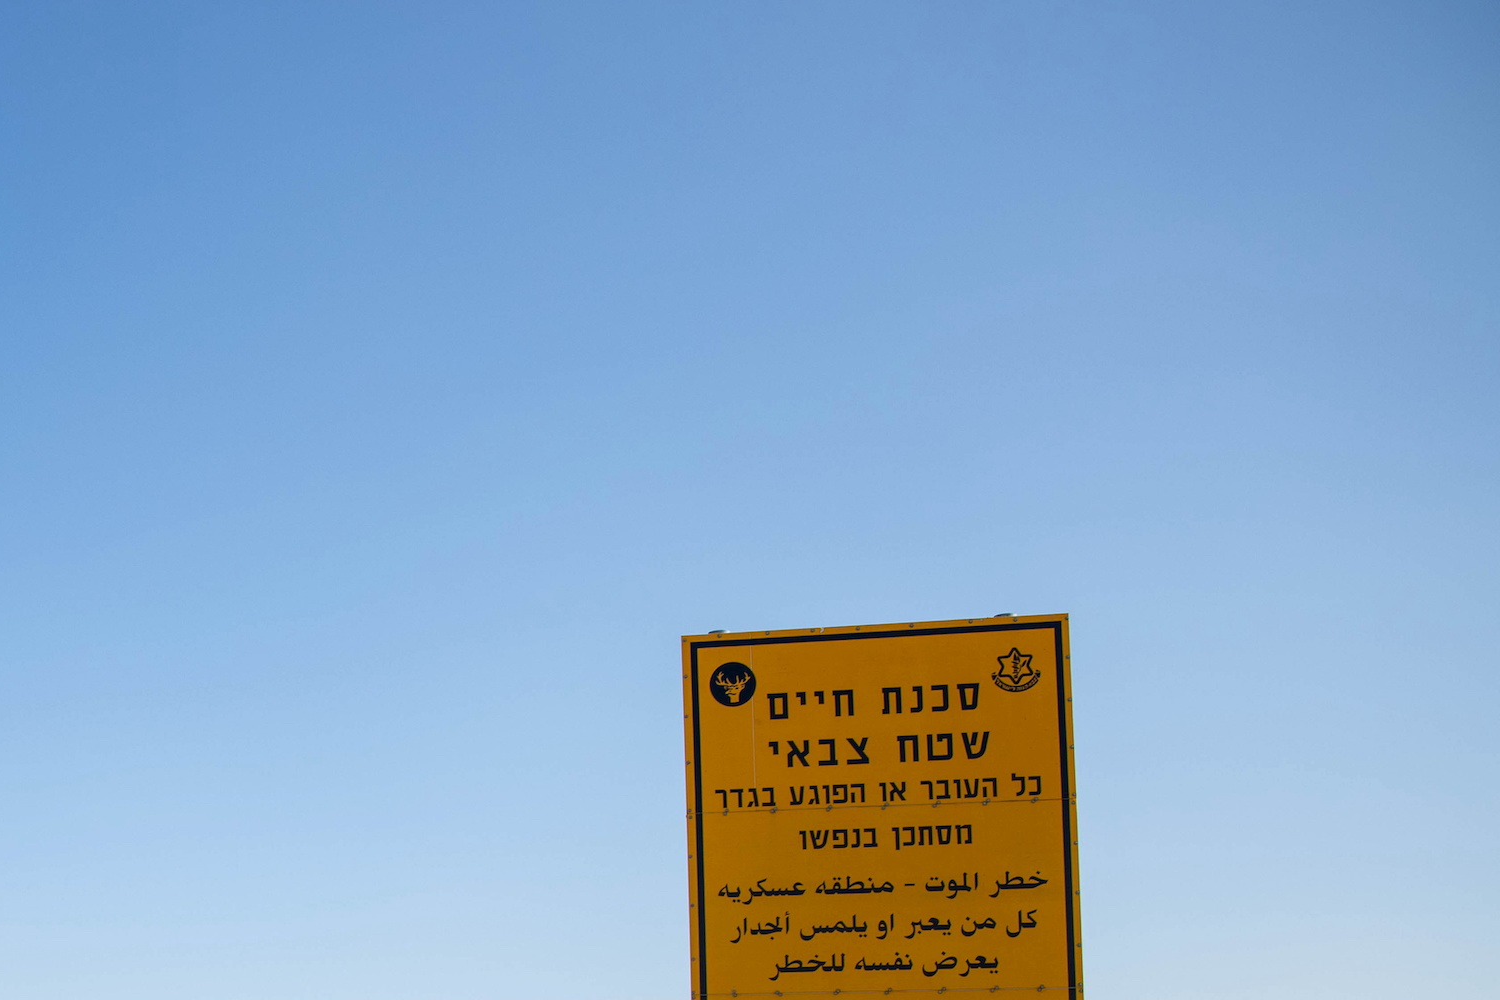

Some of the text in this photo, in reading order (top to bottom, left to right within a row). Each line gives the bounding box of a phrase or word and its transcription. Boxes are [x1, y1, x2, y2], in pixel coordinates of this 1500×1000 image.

[766, 688, 855, 721] חיים
[881, 682, 980, 715] סכנת
[768, 730, 991, 768] שטח צבאי
[714, 772, 1043, 811] כל העובר או הפוגע בגדר
[798, 823, 973, 851] מסתכן בנפשו
